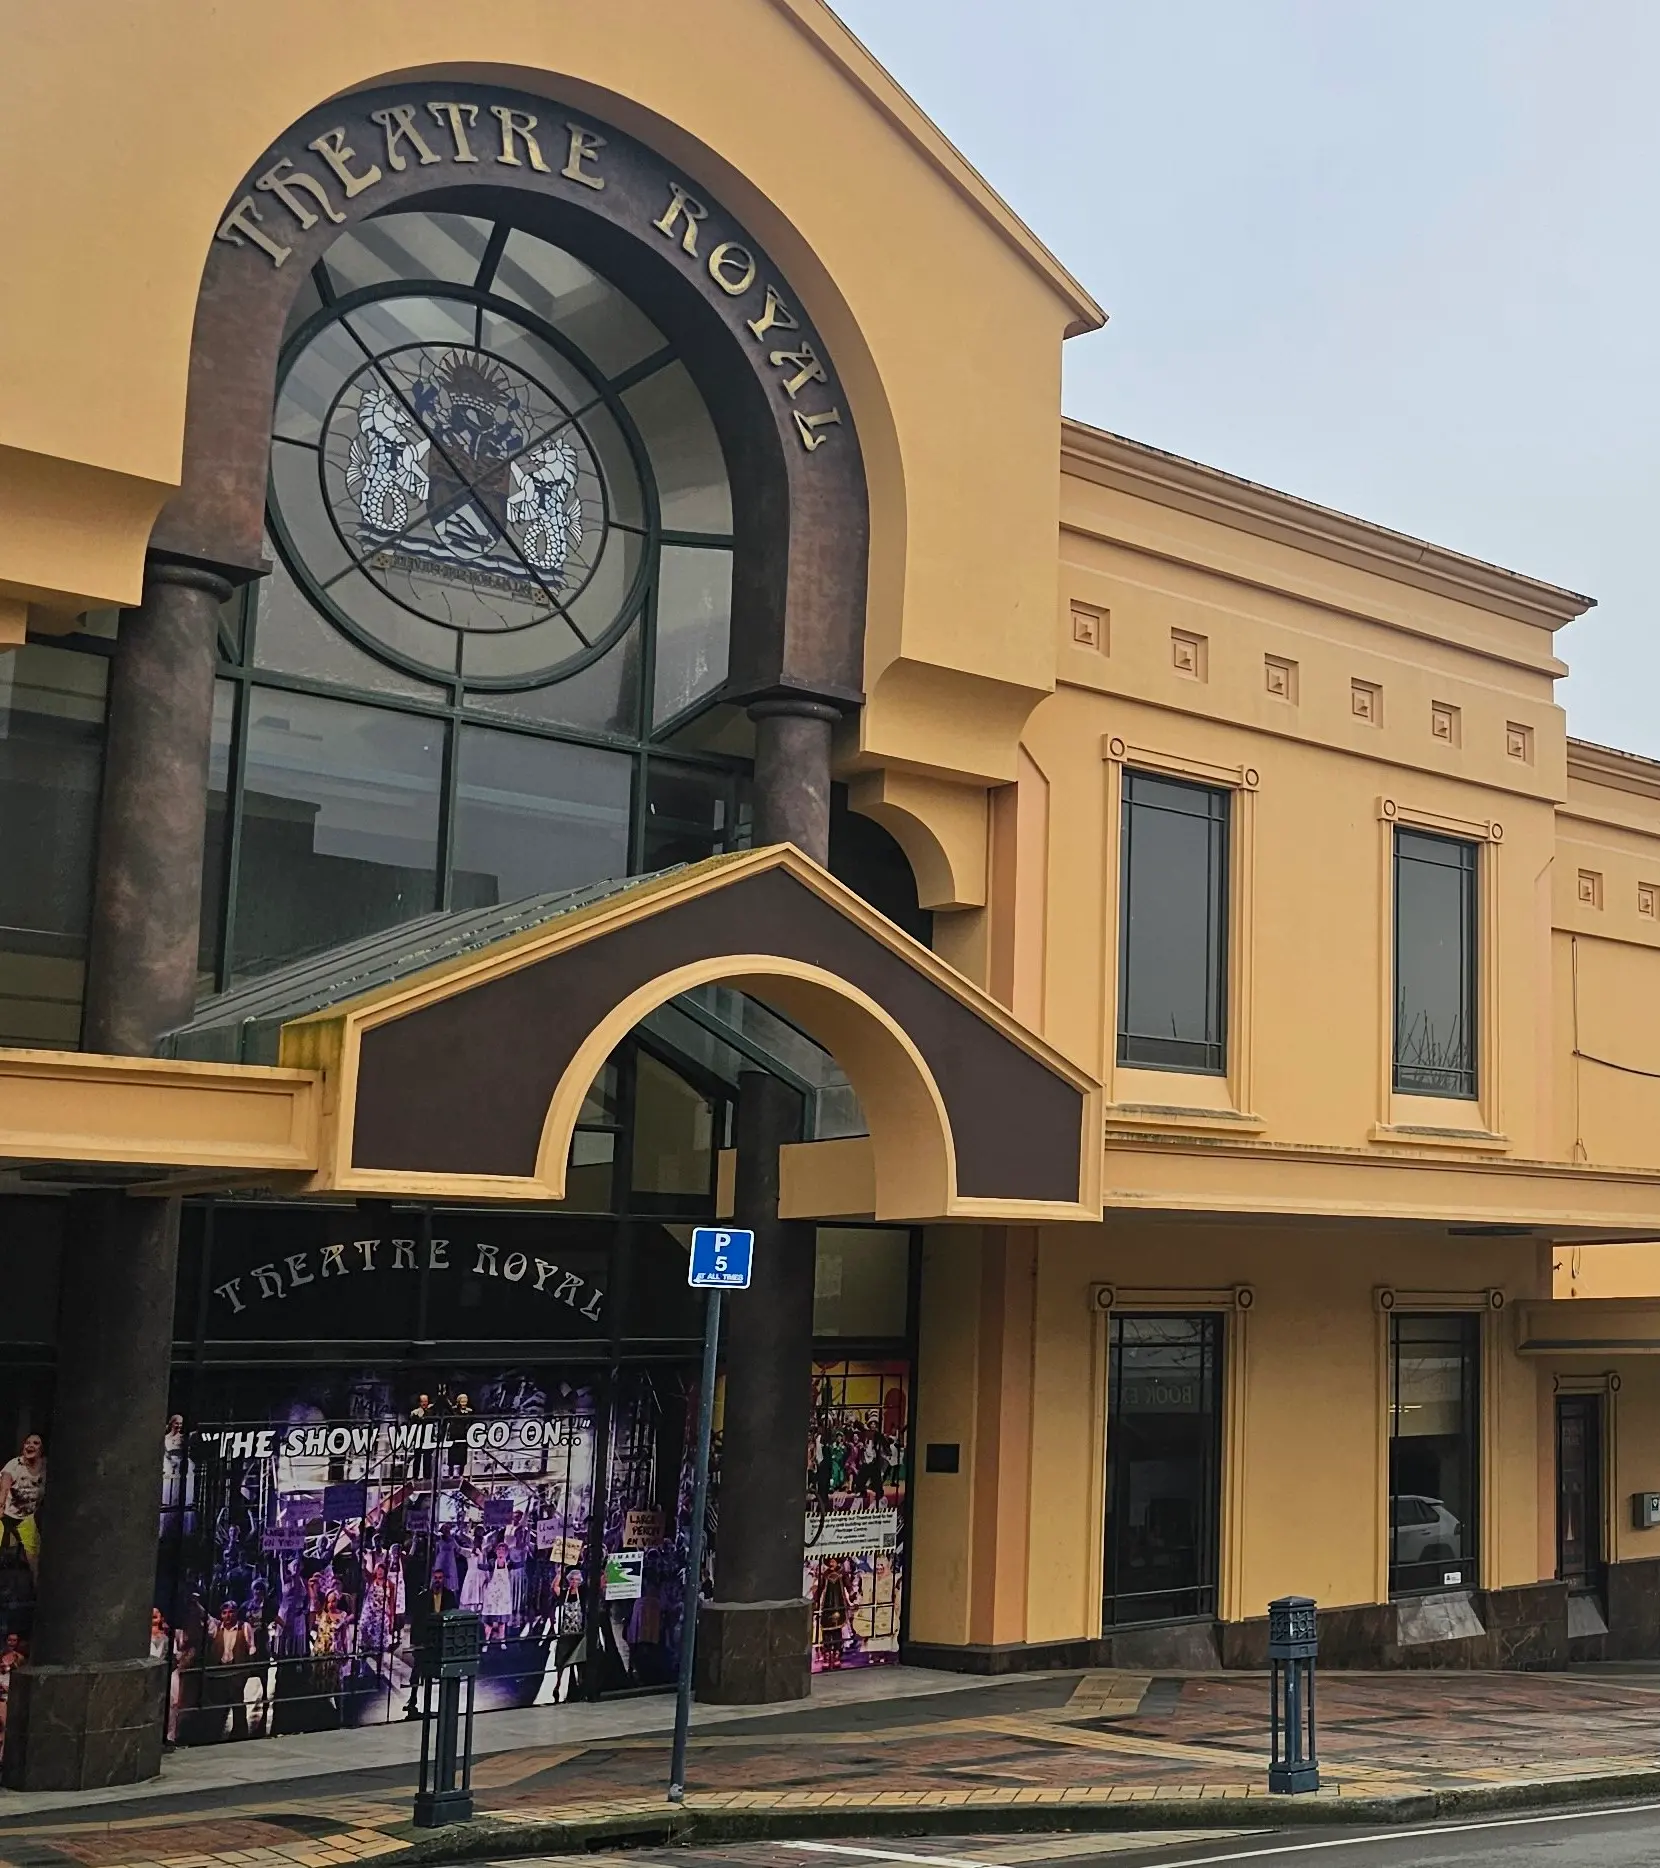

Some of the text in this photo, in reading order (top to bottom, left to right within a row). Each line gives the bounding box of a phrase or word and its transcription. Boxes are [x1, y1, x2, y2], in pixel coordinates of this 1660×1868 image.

[216, 101, 845, 453] THEATRE ROYAL
[714, 1232, 732, 1253] P
[706, 1272, 721, 1280] ALL
[714, 1255, 728, 1272] 5
[214, 1238, 604, 1322] THEATRE ROYAL
[284, 1423, 379, 1457] SHOW
[388, 1422, 455, 1450] WILL
[466, 1421, 510, 1449] GO
